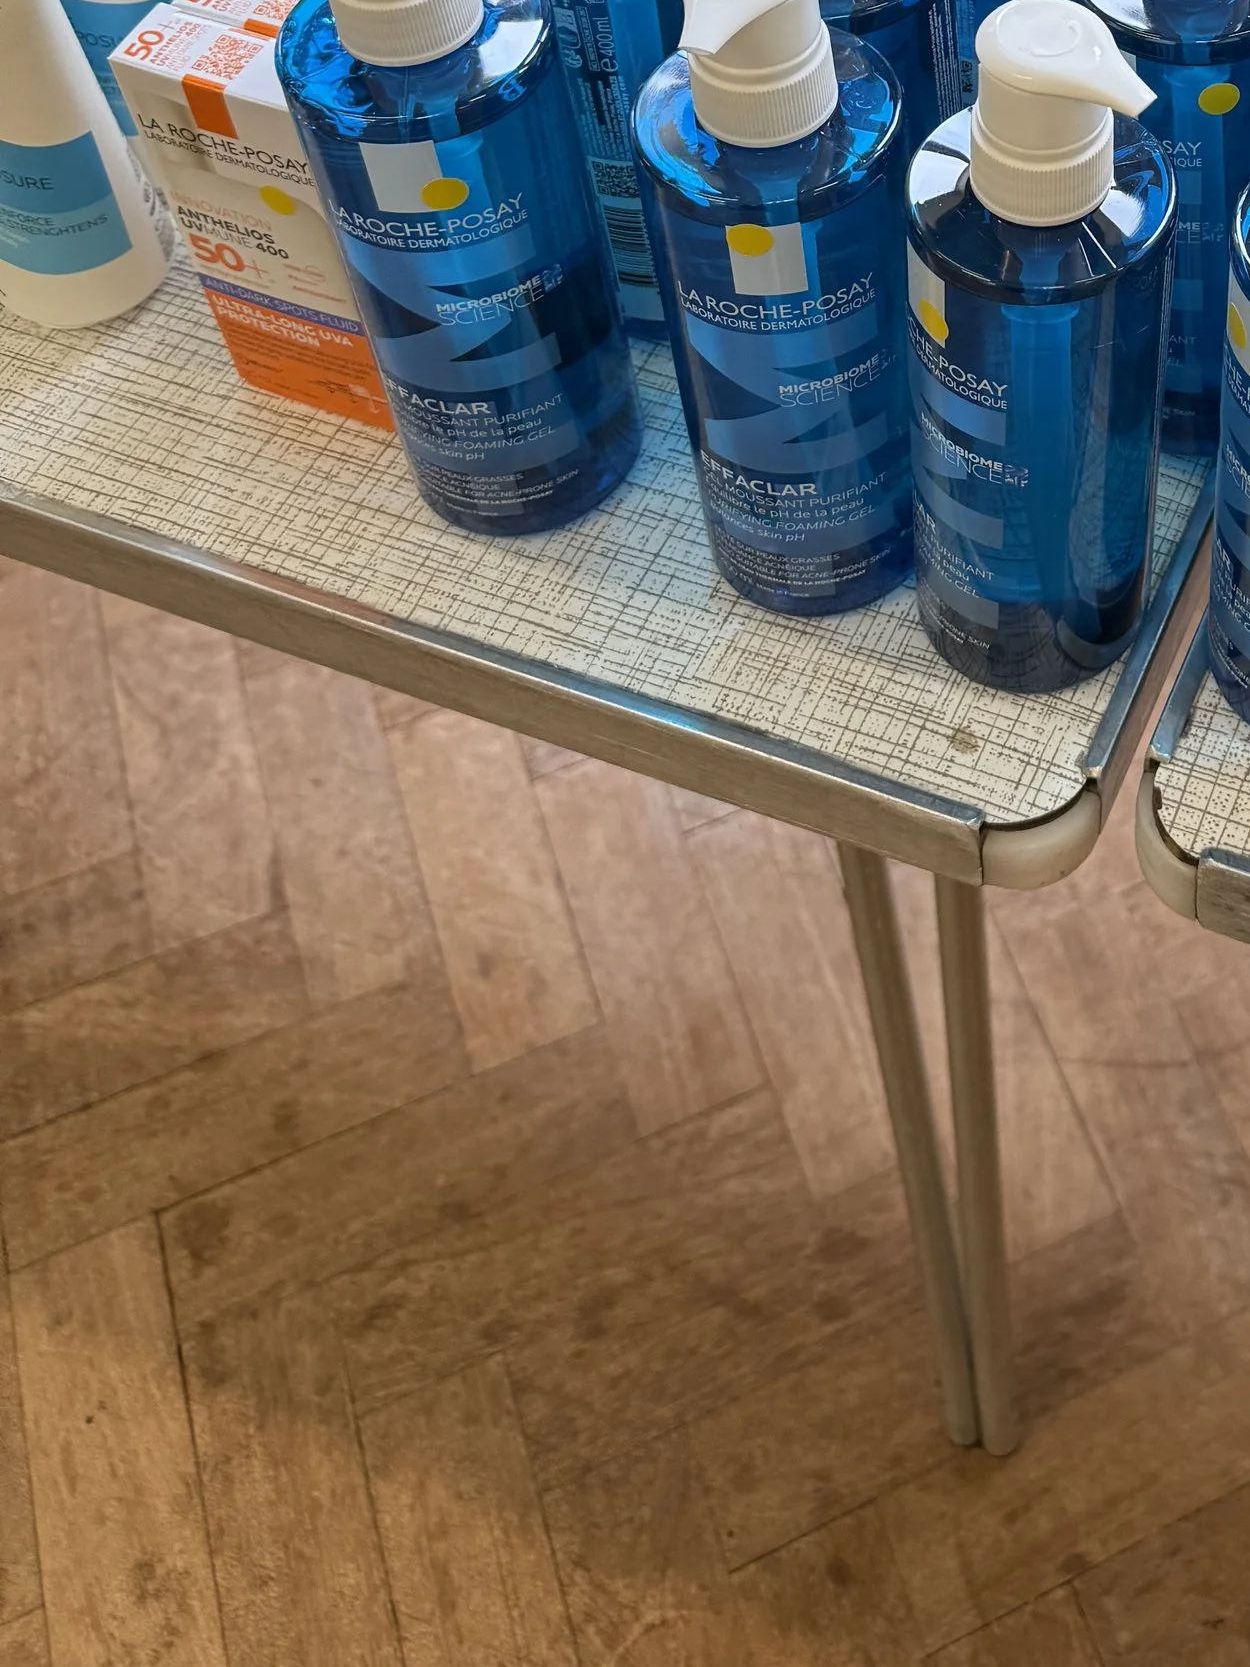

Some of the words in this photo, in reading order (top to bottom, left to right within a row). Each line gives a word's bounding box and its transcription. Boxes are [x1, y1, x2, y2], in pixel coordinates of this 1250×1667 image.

[150, 21, 194, 66] ANTHELIOS
[138, 113, 163, 131] LA
[167, 122, 309, 173] ROCHE-POSAY
[143, 129, 213, 160] LABORATOIRE
[215, 151, 316, 188] DERMATOLOGIQUE
[0, 170, 55, 191] SURE
[177, 204, 276, 245] ANTHELIOS
[328, 197, 353, 224] LA
[353, 191, 523, 238] ROCHE-POSAY
[409, 208, 529, 250] DERMATOLOGIQUE
[181, 217, 251, 249] UVMUNE
[255, 241, 290, 260] 400
[205, 277, 271, 307] ANTI-DARK
[274, 297, 318, 322] SPOTS
[320, 308, 359, 332] FLUID
[435, 274, 542, 314] MICROBIOME
[437, 285, 546, 327] SCIENCE
[677, 279, 703, 307] LA
[705, 271, 874, 320] ROCHE-POSAY
[680, 296, 758, 331] LABORATOIRE
[760, 287, 877, 332] DERMATOLOGIQUE
[211, 294, 316, 336] ULTRA-LONG
[318, 328, 354, 348] UVA
[216, 306, 321, 348] PROTECTION
[778, 352, 880, 395] MICROBIOME
[908, 316, 1008, 397] CHE-POSAY
[779, 364, 881, 408] SCIENCE
[915, 346, 1008, 410] DERMATOLOGIQUE
[447, 427, 466, 439] pH
[469, 429, 488, 438] de
[508, 417, 543, 435] peau
[484, 392, 564, 427] PURIFIANT
[454, 434, 524, 451] FOAMING
[527, 425, 556, 442] GEL
[466, 451, 485, 462] pH
[921, 411, 1003, 471] MICROBIOME
[922, 428, 1003, 485] SCIENCE
[700, 448, 818, 496] EFFACLAR
[725, 482, 805, 509] MOUSSANT
[809, 470, 888, 507] PURIFIANT
[754, 504, 766, 516] le
[770, 509, 789, 521] pH
[793, 509, 812, 519] de
[815, 507, 828, 518] la
[831, 497, 865, 516] peau
[775, 514, 846, 531] FOAMING
[848, 503, 876, 522] GEL
[757, 526, 783, 540] skin
[785, 532, 805, 543] pH
[791, 552, 841, 564] GRASSES
[954, 581, 980, 599] GEL
[968, 634, 992, 650] SKIN
